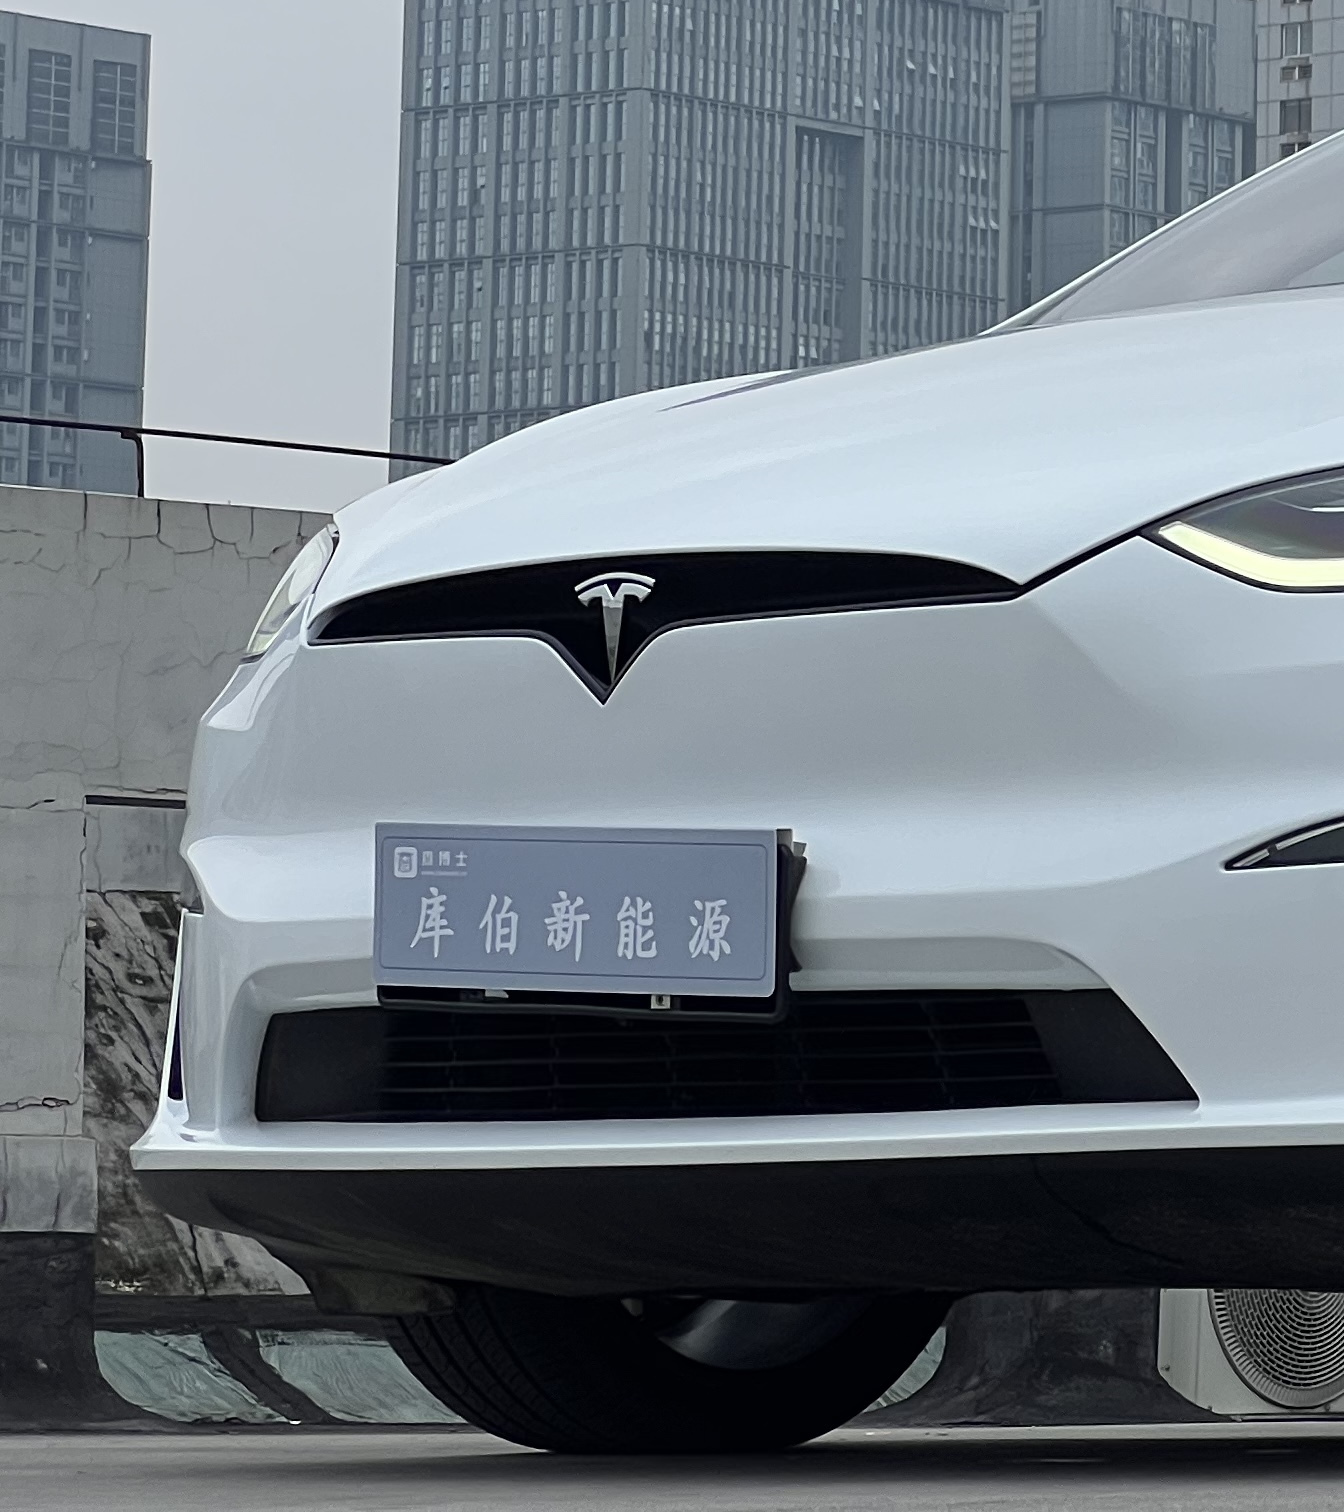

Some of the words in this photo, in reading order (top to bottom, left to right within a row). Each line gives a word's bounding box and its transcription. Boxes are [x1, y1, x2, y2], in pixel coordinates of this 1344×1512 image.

[409, 886, 732, 963] 库伯新能源
